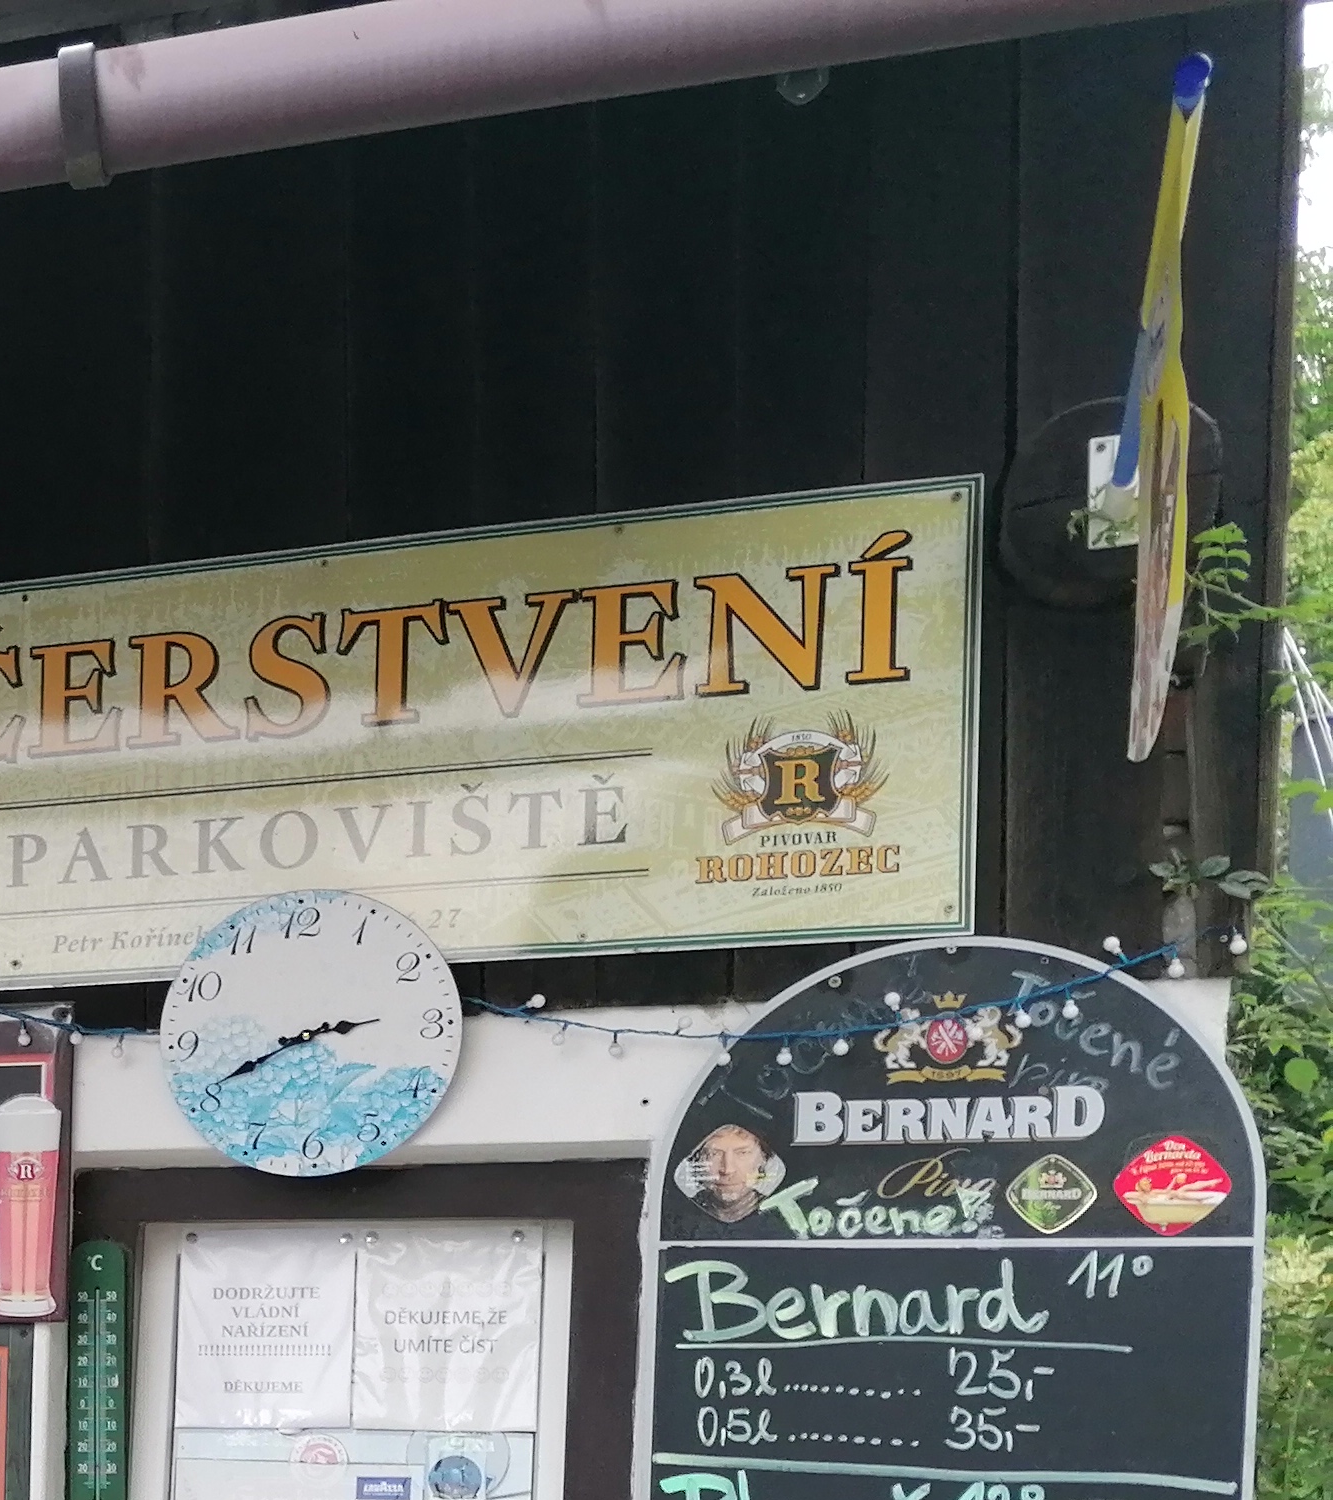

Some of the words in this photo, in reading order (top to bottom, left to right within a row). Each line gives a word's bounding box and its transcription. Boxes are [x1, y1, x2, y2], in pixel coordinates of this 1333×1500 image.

[7, 775, 630, 892] PARKOVIŠTĚ
[760, 831, 837, 847] PIVOVAR
[695, 845, 900, 884] ROHOZEC
[752, 884, 810, 898] Založeno
[815, 883, 843, 894] 1850
[52, 933, 98, 955] Petr
[791, 1084, 1106, 1147] BERNARD
[212, 1285, 320, 1301] DODRŽUJTE
[665, 1257, 1050, 1343] Bernard
[231, 1304, 300, 1319] VLÁDNÍ
[221, 1322, 308, 1338] NAŘÍZENÍ
[394, 1337, 453, 1354] UMÍTE
[459, 1335, 498, 1354] ČÍST
[223, 1380, 303, 1393] DĚKUJEME
